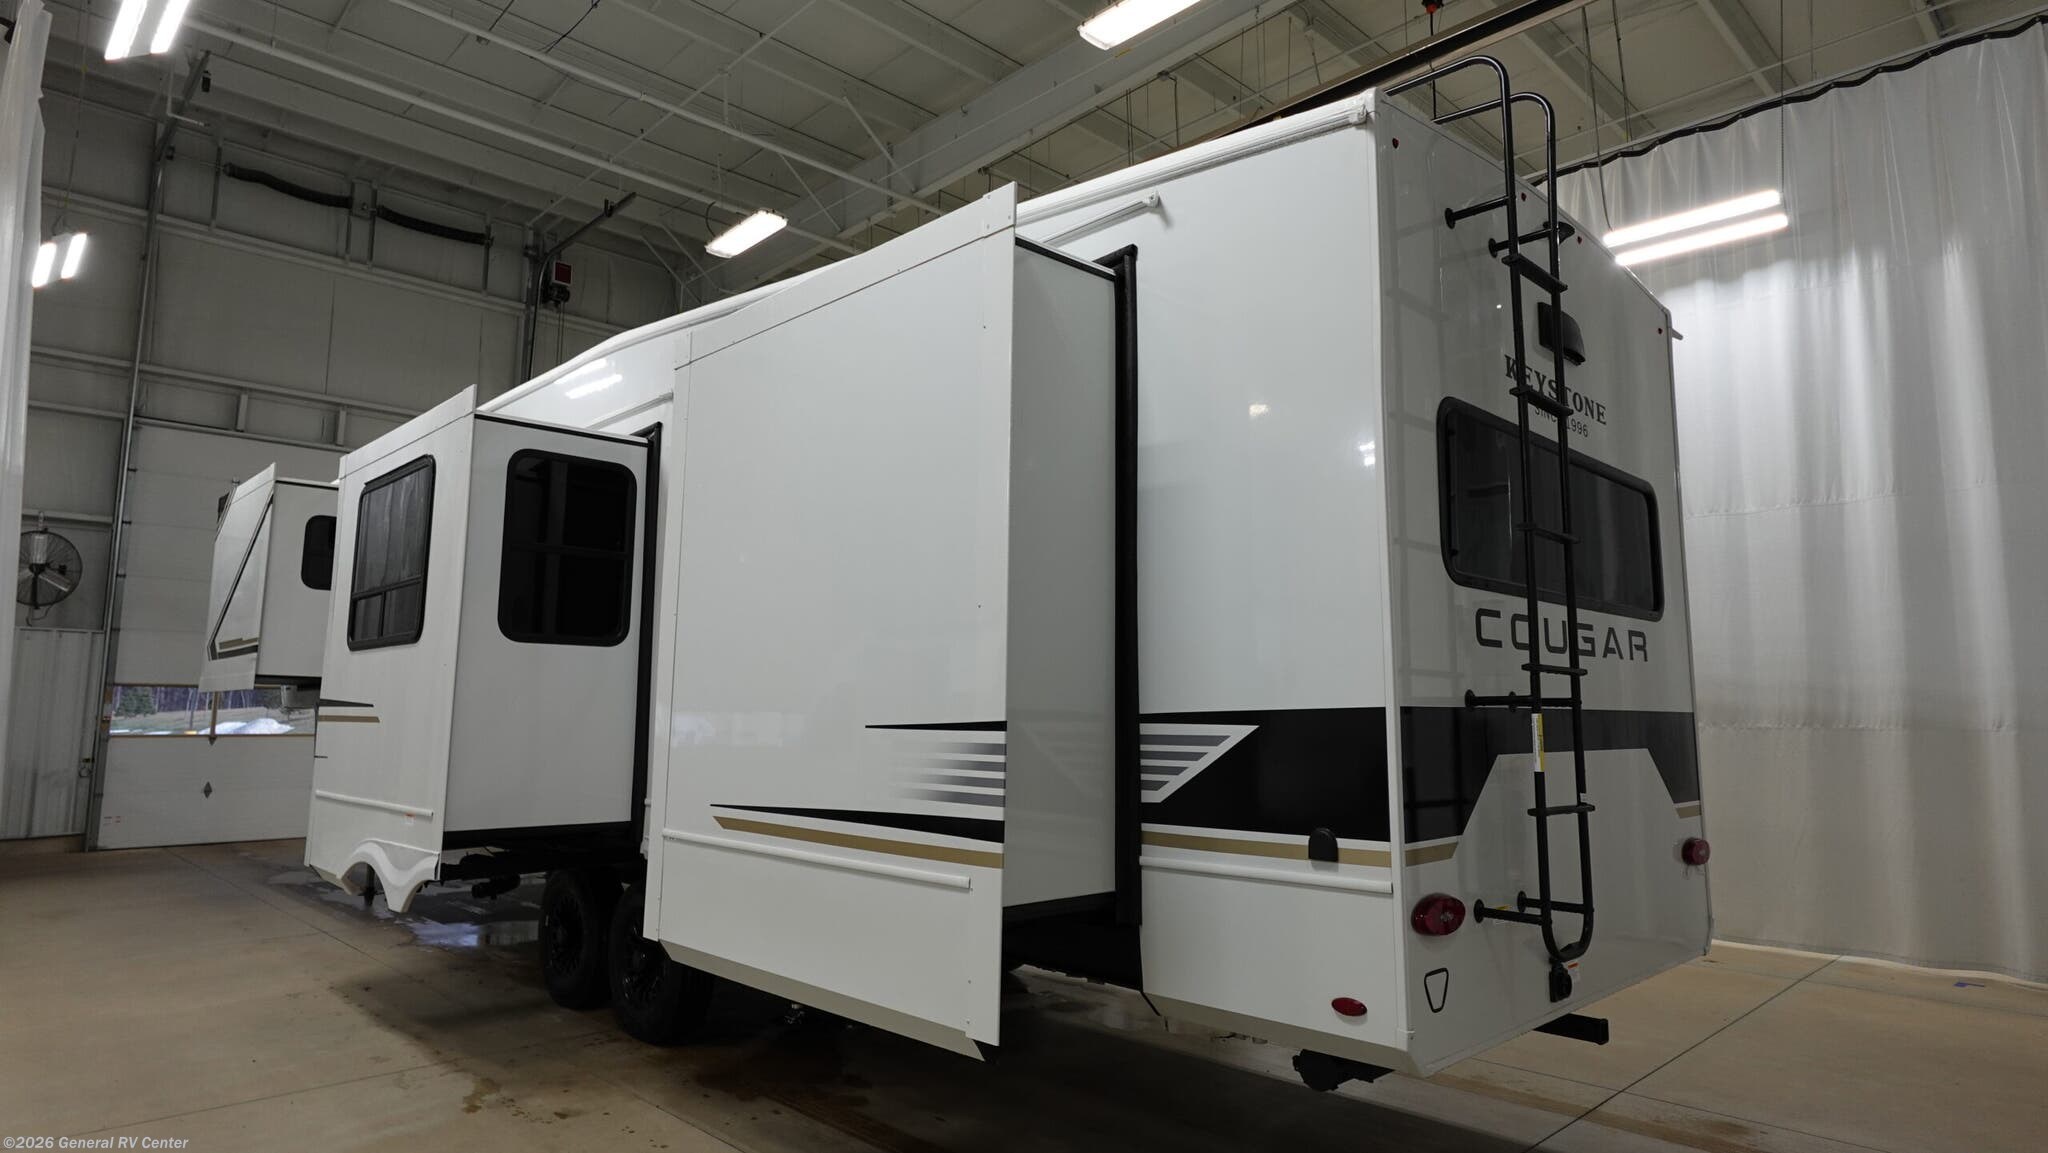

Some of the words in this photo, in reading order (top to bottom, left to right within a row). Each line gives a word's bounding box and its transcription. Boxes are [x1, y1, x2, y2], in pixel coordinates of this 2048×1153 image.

[1535, 406, 1559, 423] SINC
[1566, 418, 1589, 438] 1996
[1475, 608, 1648, 662] COUGAR
